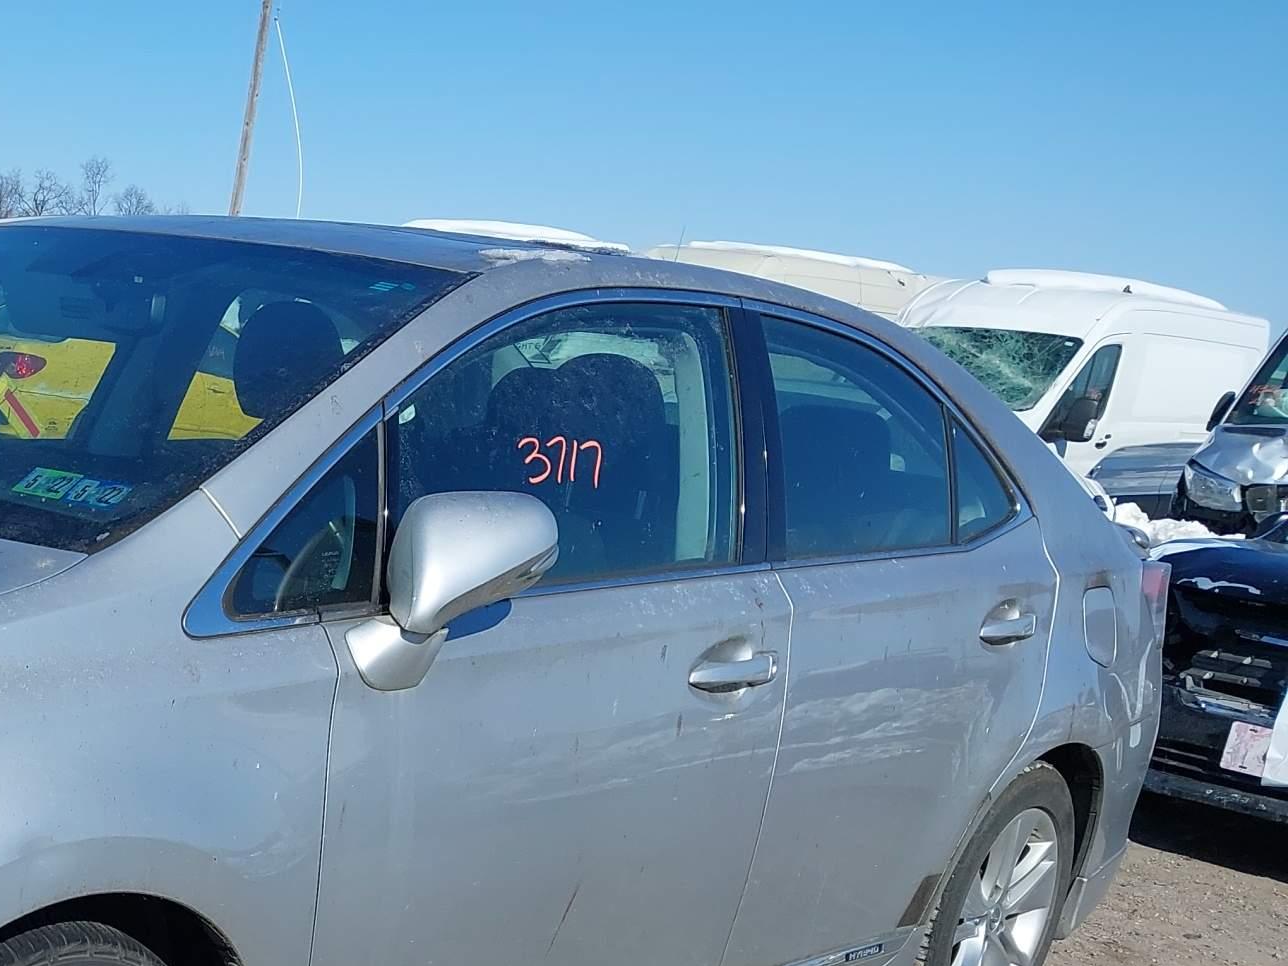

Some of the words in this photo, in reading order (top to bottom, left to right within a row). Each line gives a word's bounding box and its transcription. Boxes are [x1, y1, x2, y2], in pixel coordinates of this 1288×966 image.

[518, 436, 601, 488] 3717
[23, 474, 42, 489] 5
[73, 484, 92, 500] 5
